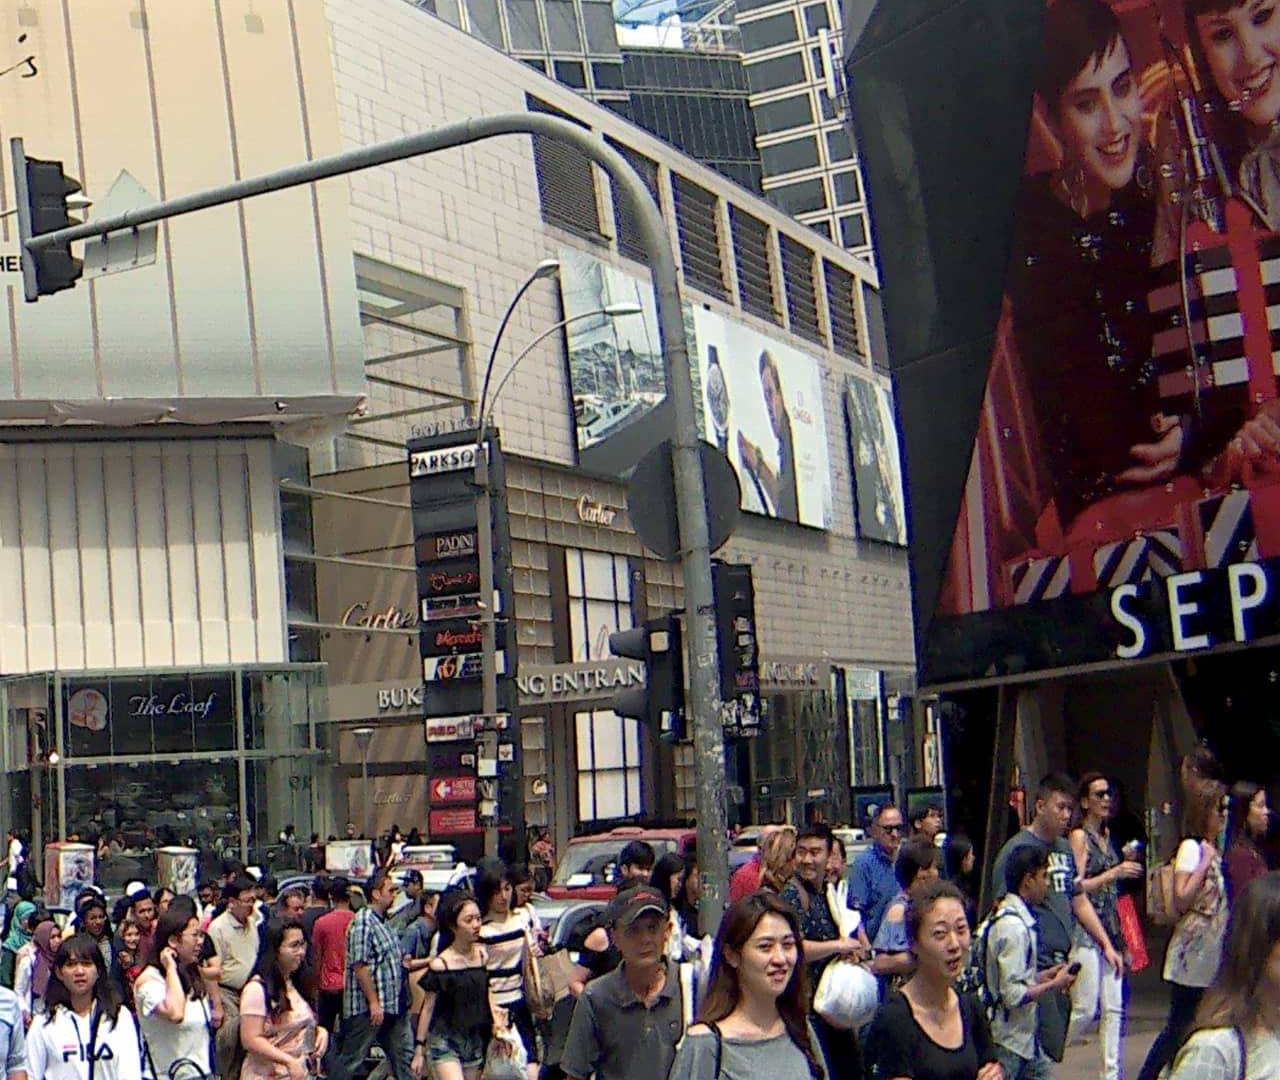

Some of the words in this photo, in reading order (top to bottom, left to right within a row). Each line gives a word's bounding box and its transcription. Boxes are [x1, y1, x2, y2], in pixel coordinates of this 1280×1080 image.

[411, 448, 476, 473] PARKSO
[1110, 562, 1268, 659] SEP
[378, 687, 424, 709] BUK
[551, 665, 645, 693] ENTRAN
[129, 695, 164, 717] The
[166, 692, 217, 719] Loaf
